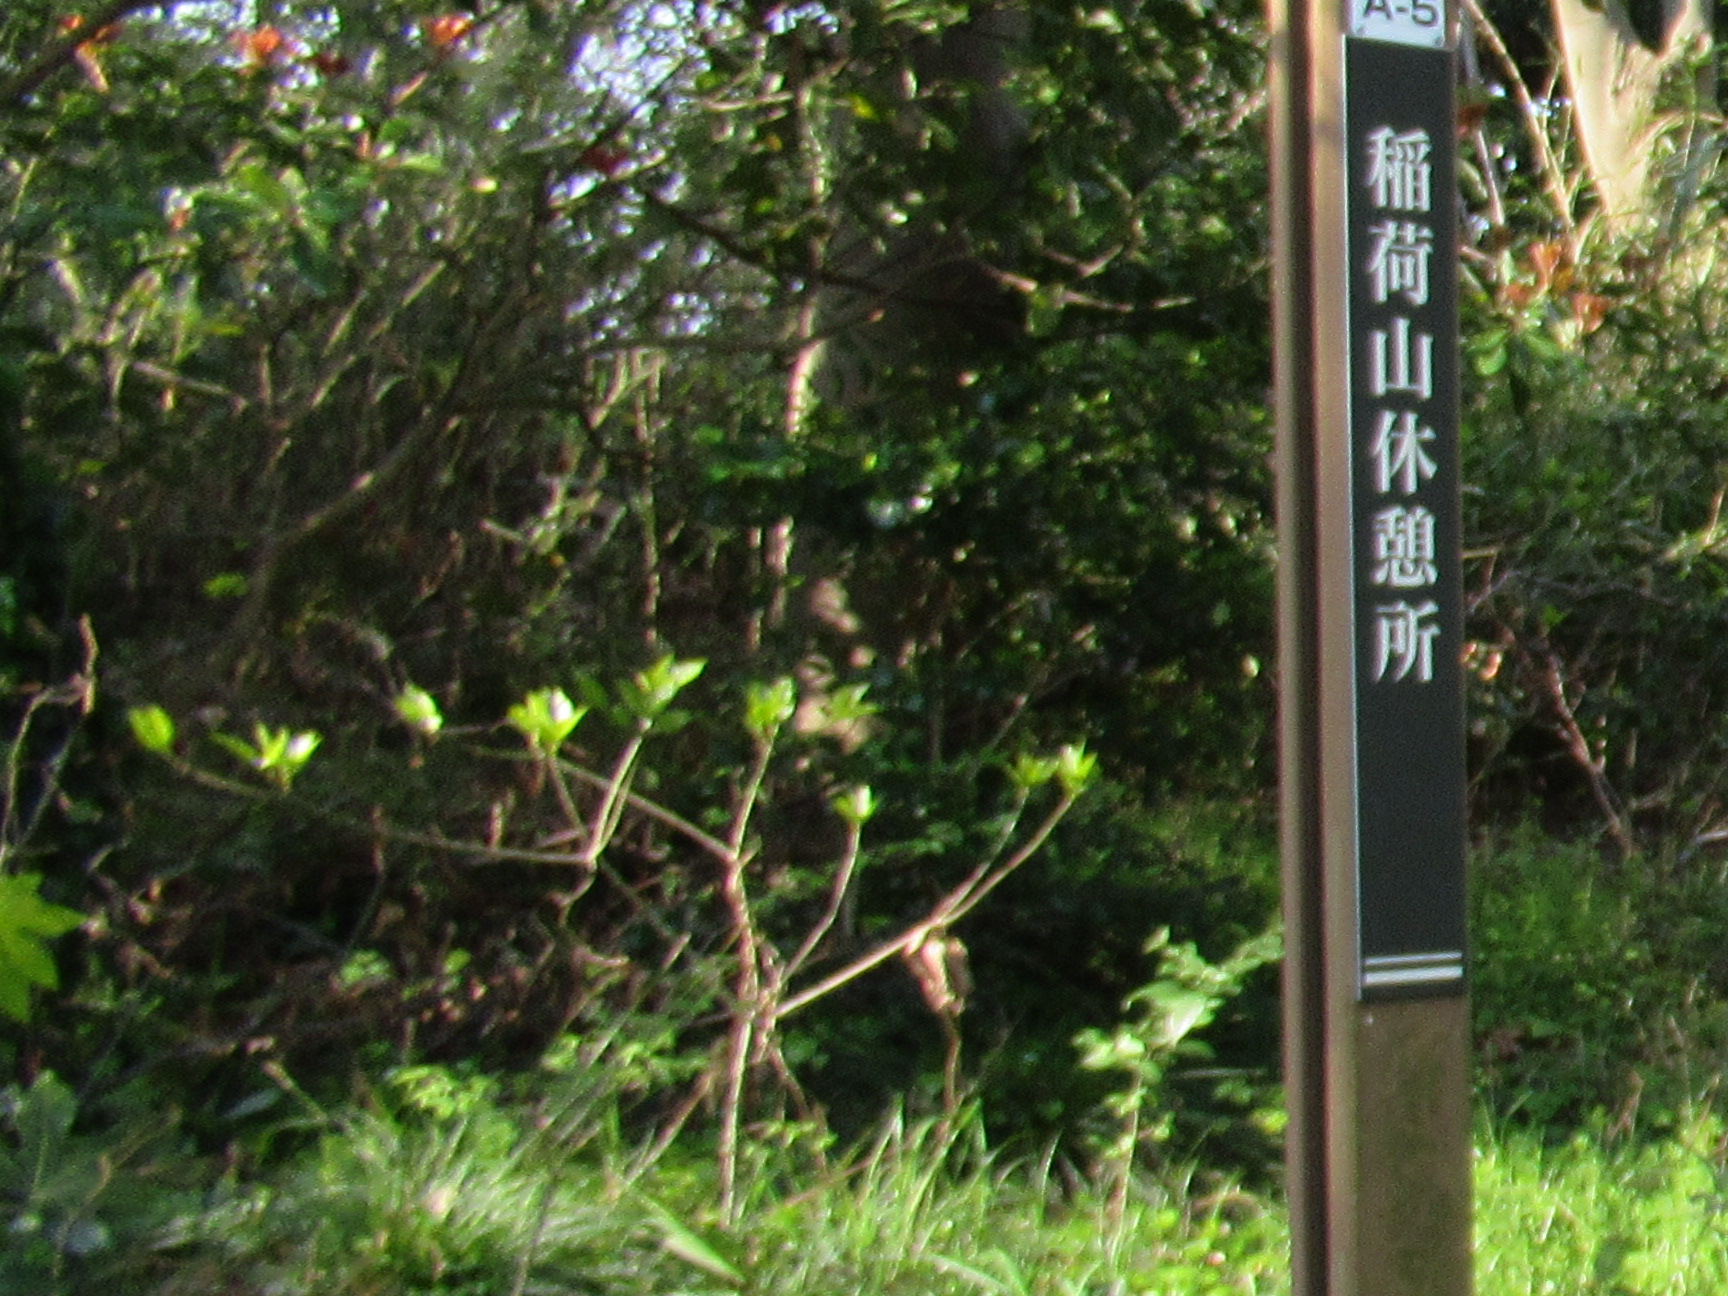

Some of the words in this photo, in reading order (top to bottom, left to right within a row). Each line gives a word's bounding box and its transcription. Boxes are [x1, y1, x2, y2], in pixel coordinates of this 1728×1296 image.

[1364, 124, 1442, 685] 稲荷山休憩所
